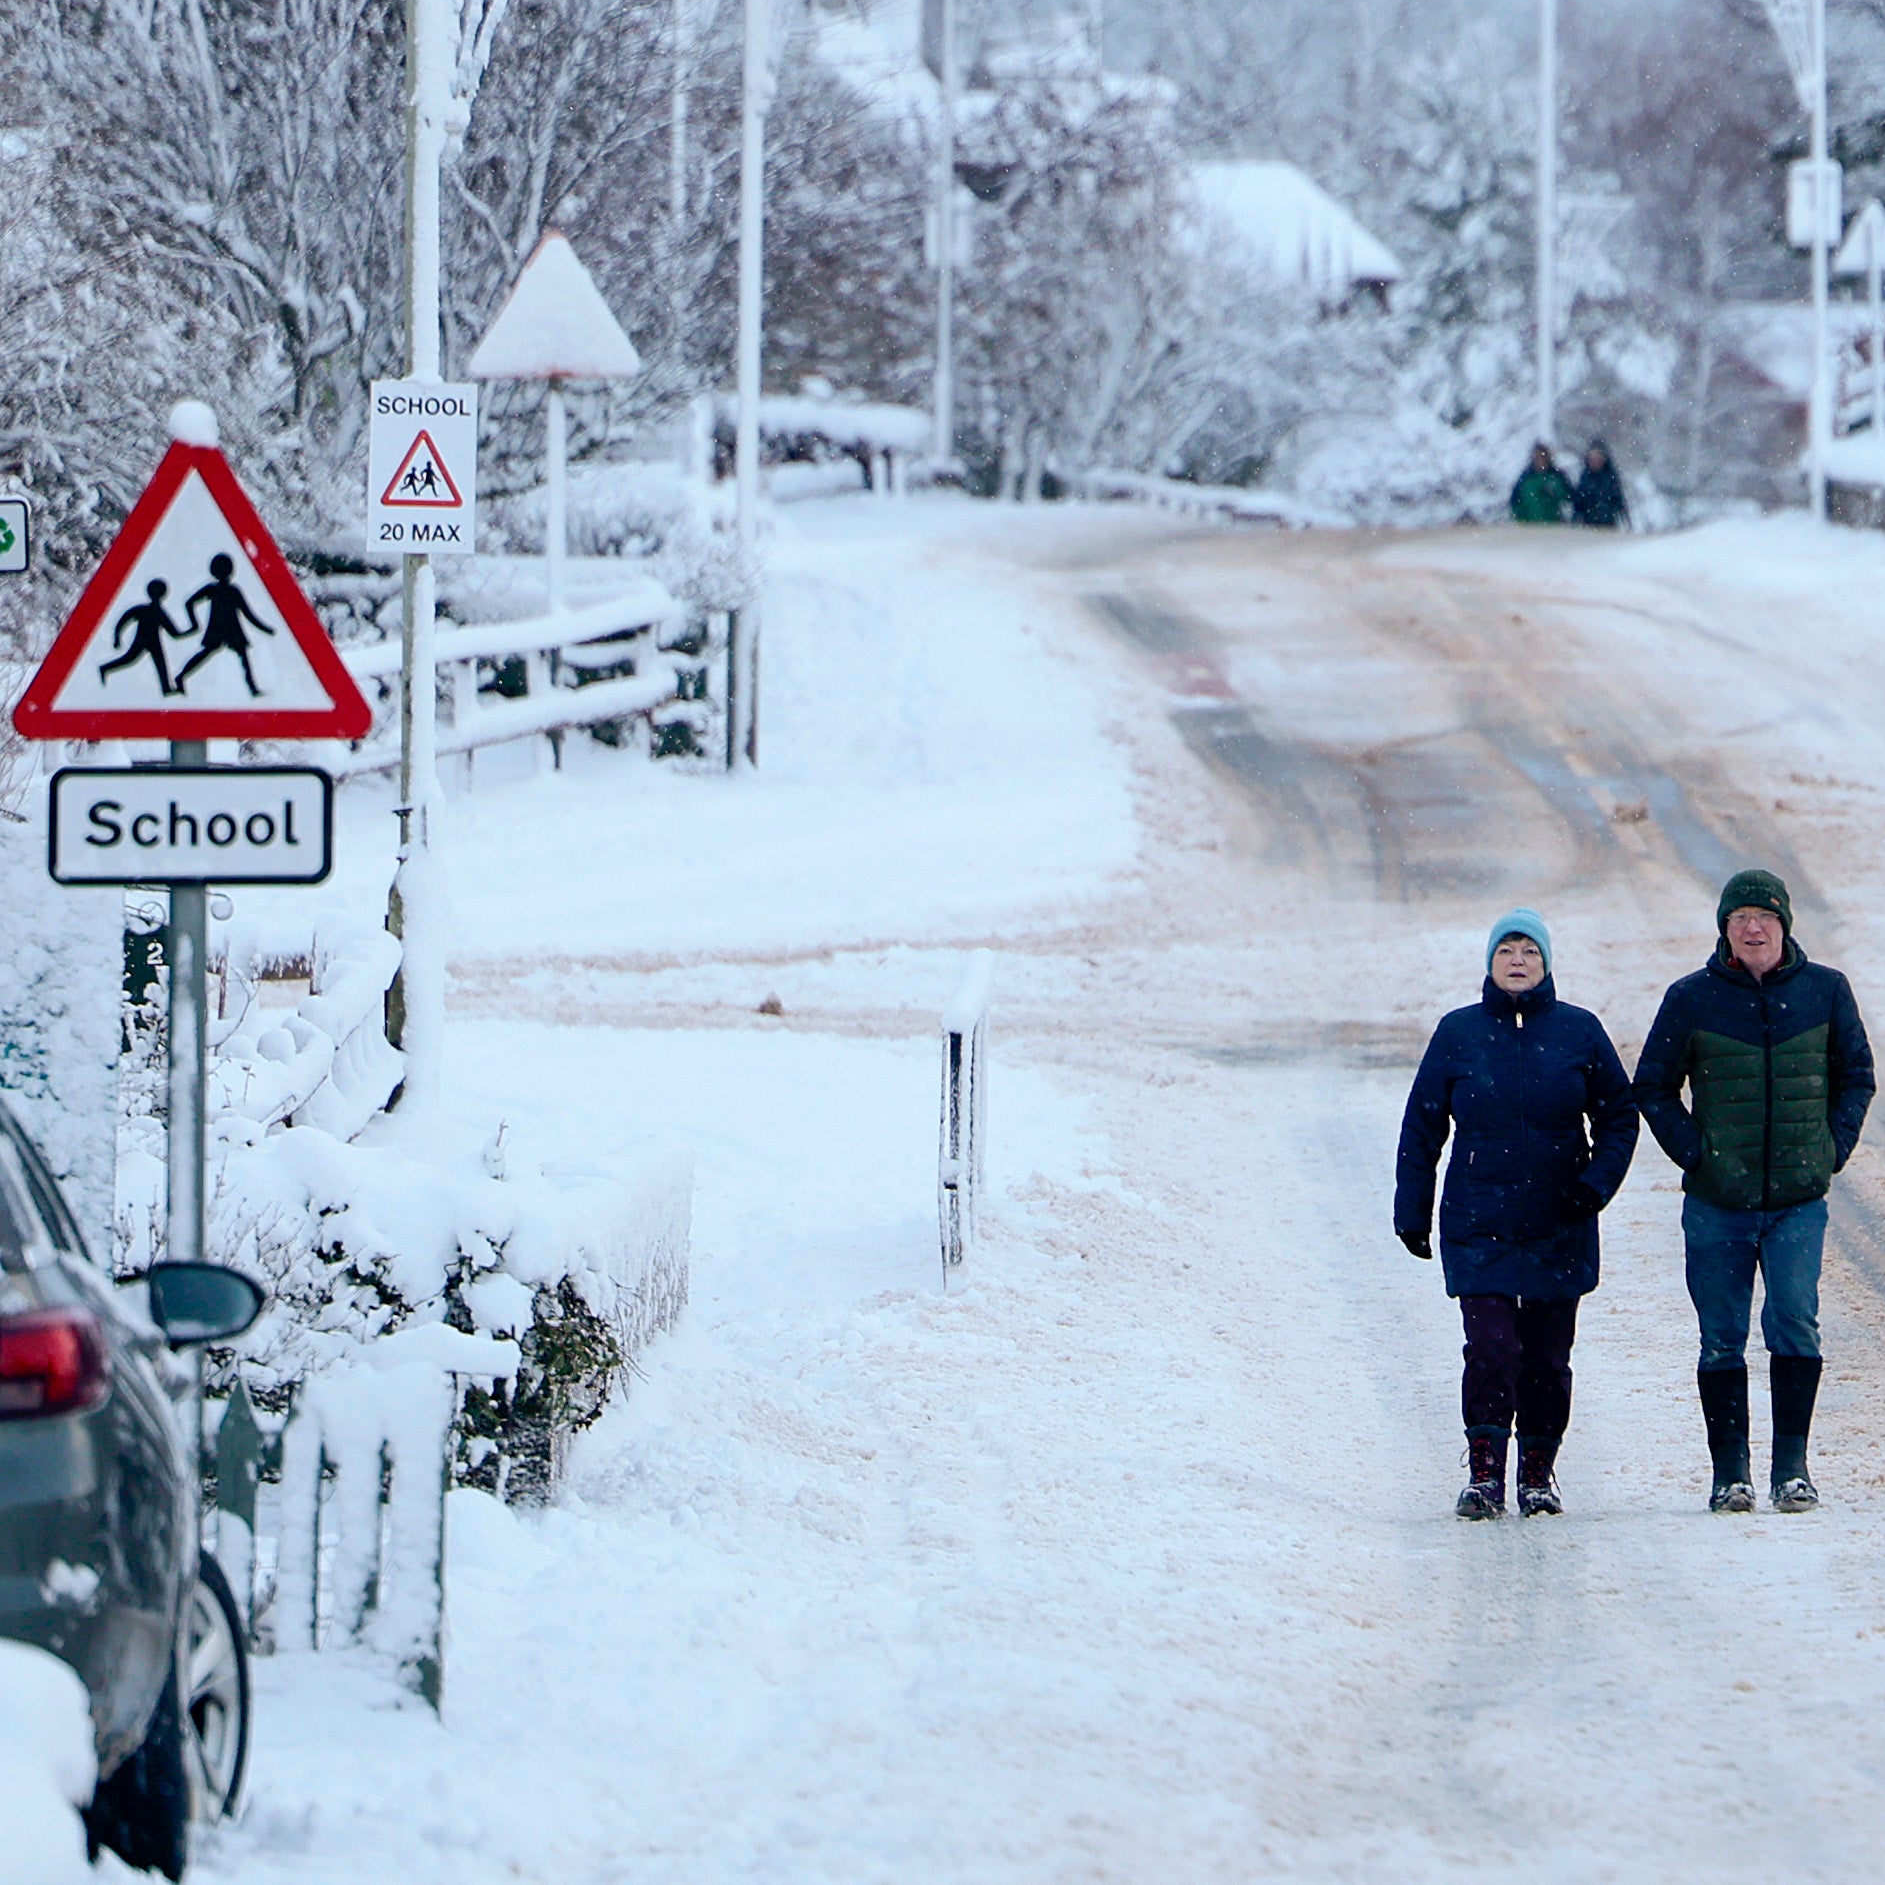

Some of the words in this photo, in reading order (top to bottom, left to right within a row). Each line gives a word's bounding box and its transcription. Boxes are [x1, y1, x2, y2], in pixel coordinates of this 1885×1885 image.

[376, 395, 471, 417] SCHOOL
[379, 523, 405, 542] 20
[411, 523, 461, 542] MAX
[85, 800, 300, 847] School
[146, 941, 164, 965] 2
